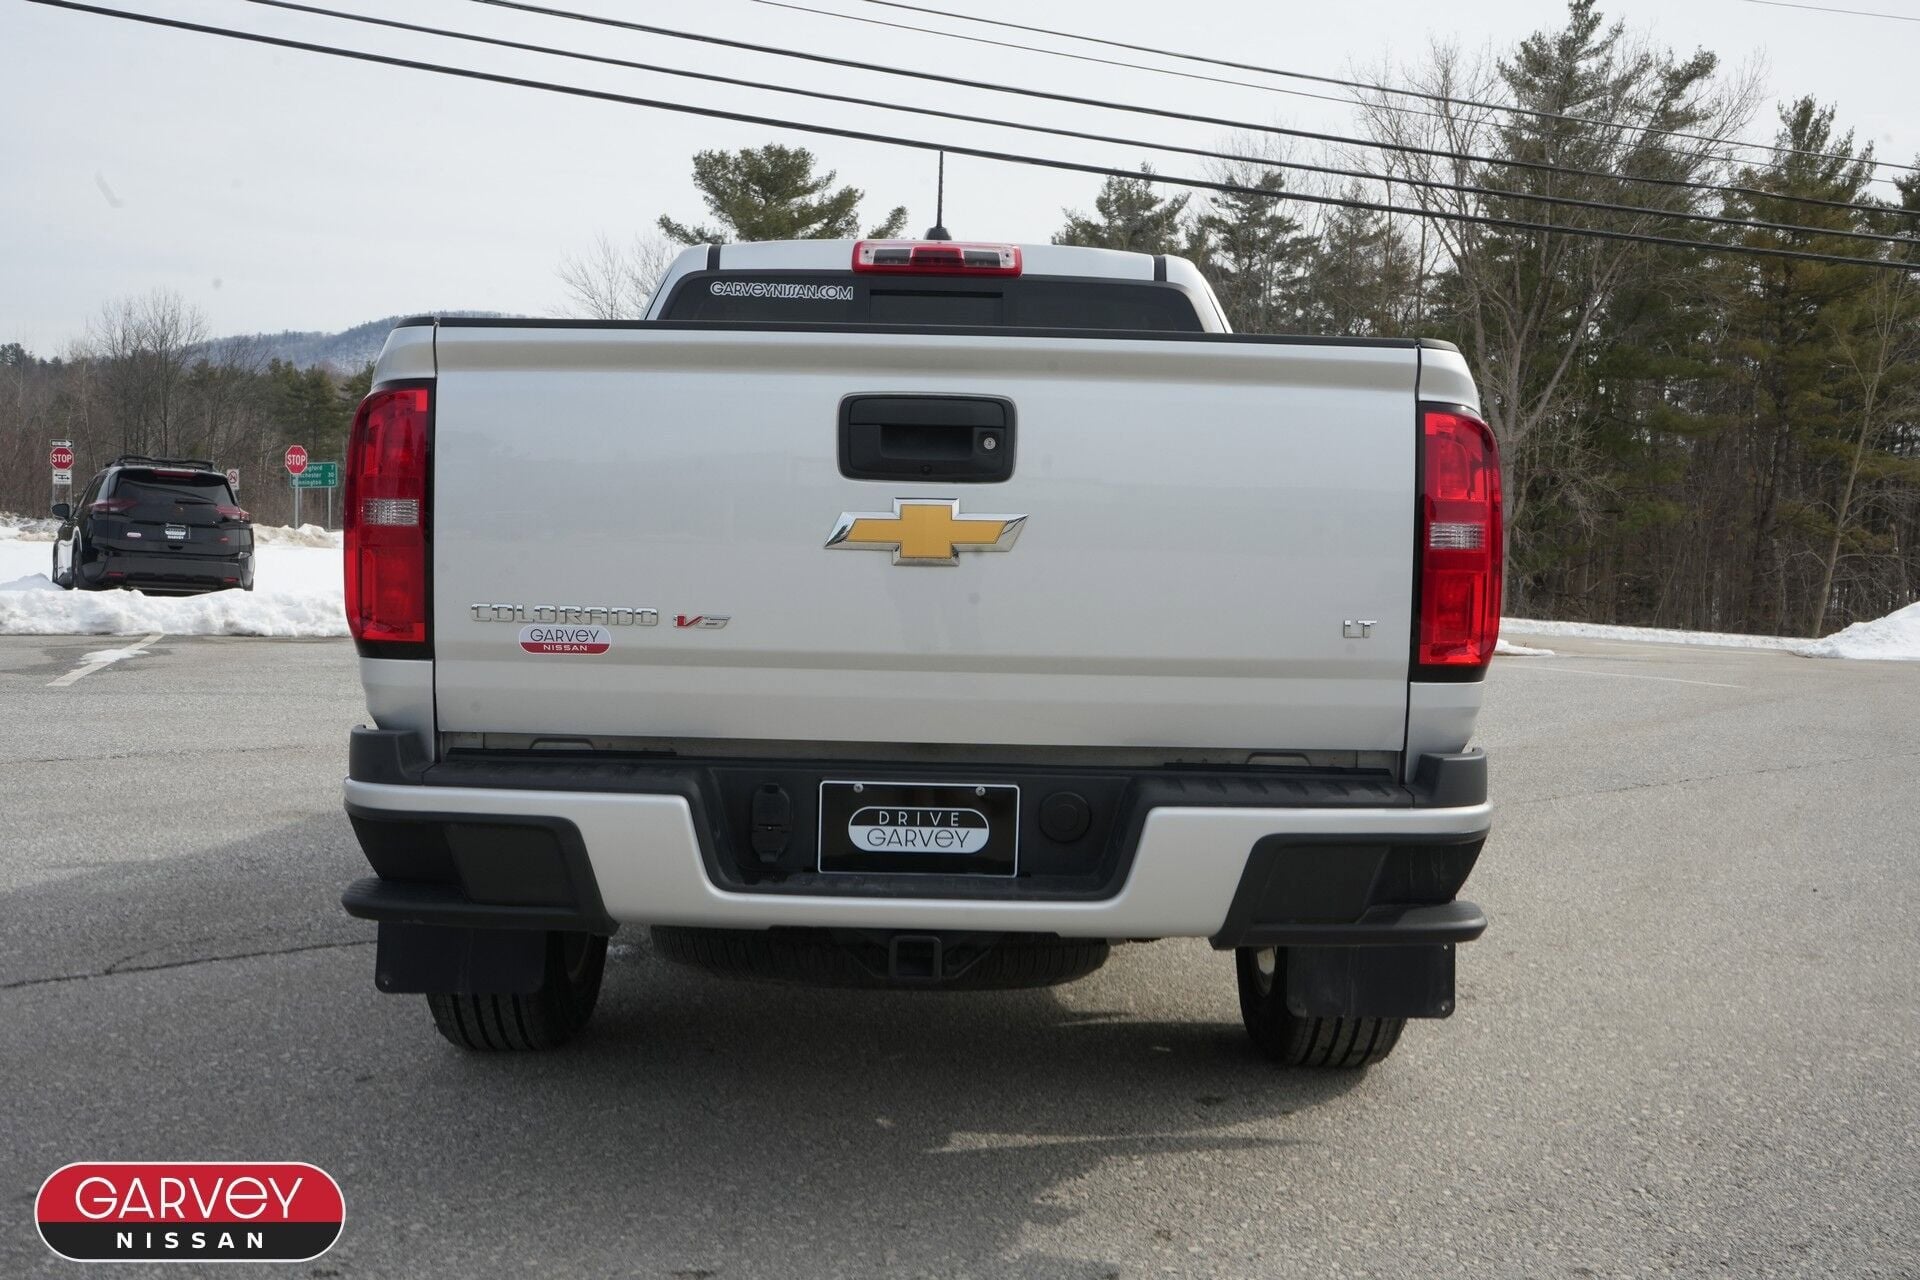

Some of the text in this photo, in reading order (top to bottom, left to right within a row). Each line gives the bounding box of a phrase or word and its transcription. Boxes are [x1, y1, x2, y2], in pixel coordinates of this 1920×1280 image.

[710, 281, 854, 300] GARVEYNISSAN.COM
[52, 453, 72, 463] STOP
[287, 454, 306, 466] STOP
[471, 603, 659, 627] COLORADO
[530, 628, 600, 643] GARVEY
[1343, 620, 1377, 639] LT
[543, 644, 588, 652] NISSAN
[878, 810, 960, 827] DRIVE
[866, 827, 970, 849] GARVEY
